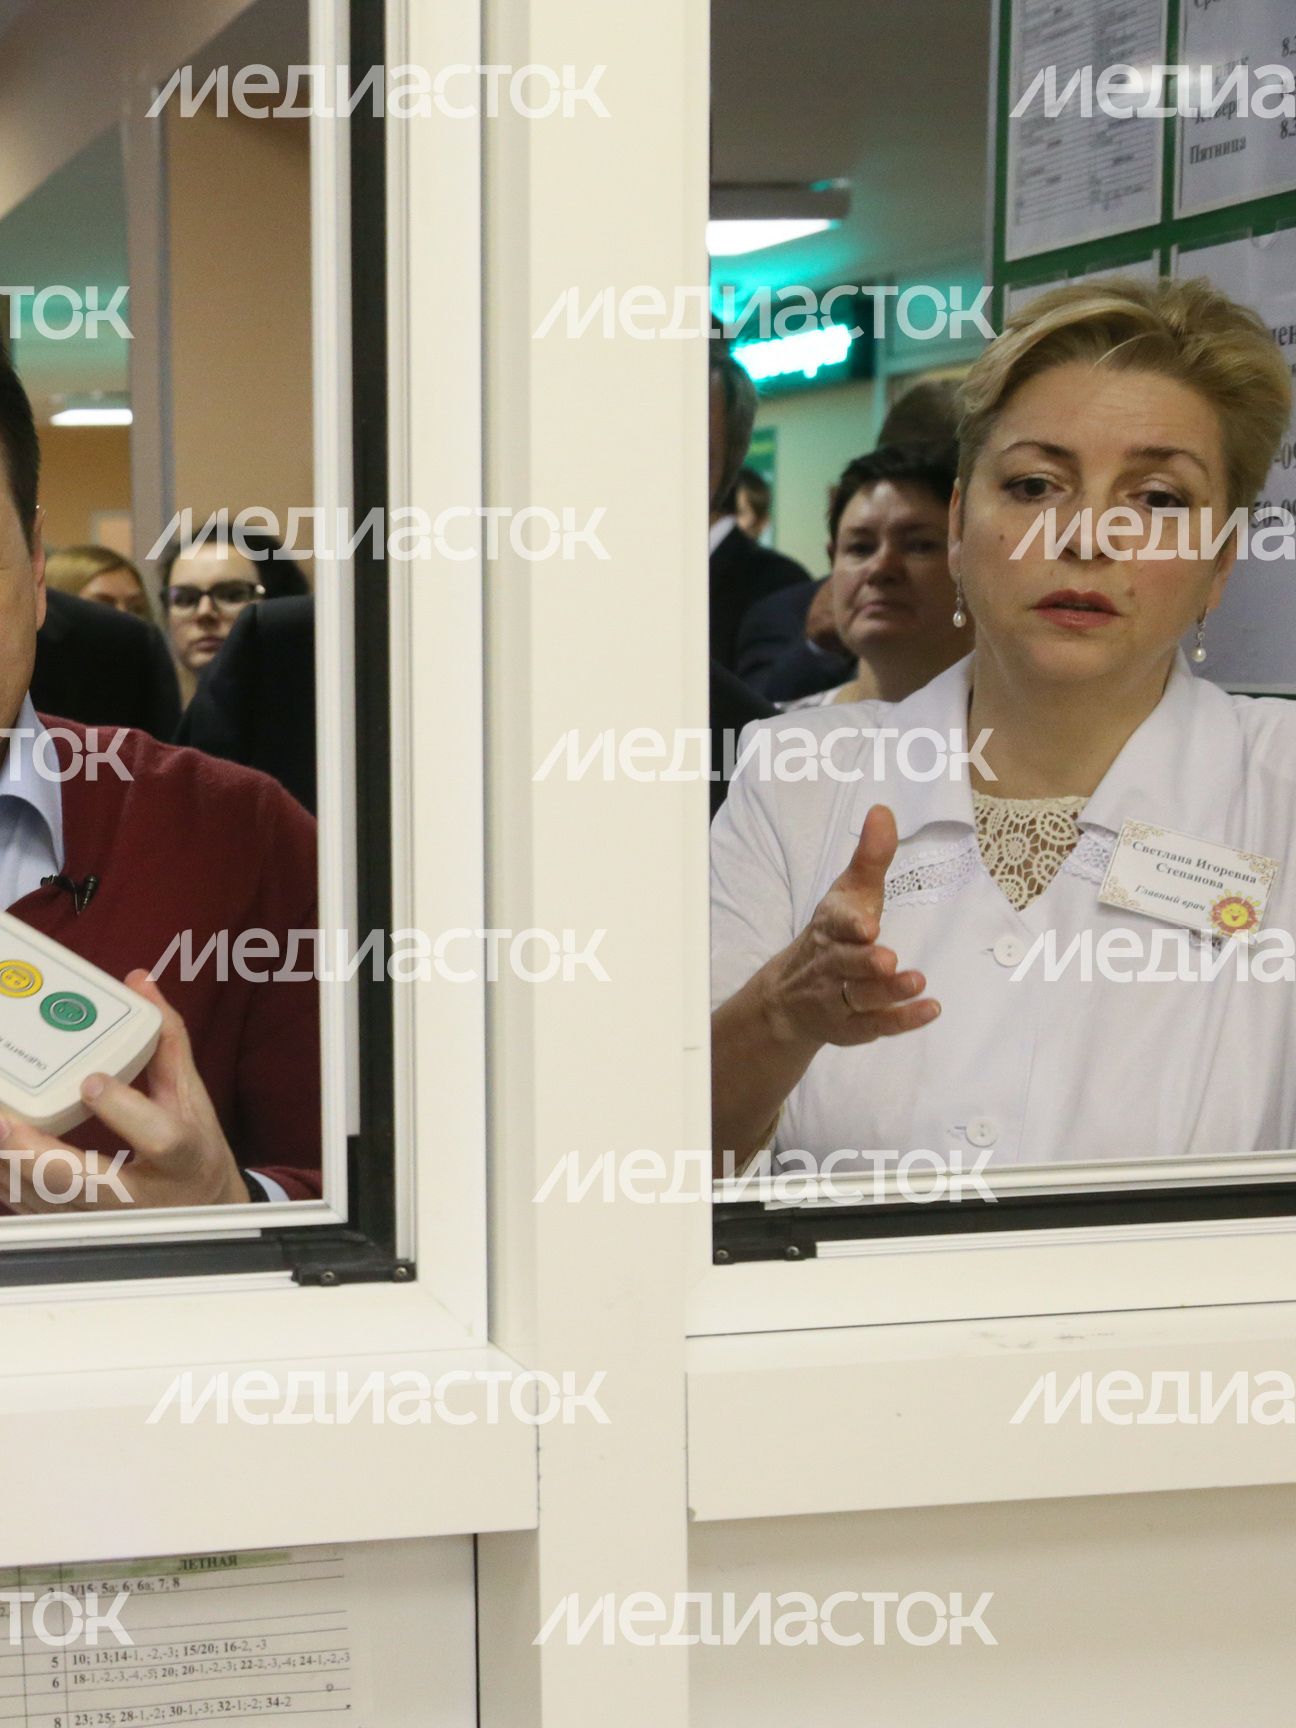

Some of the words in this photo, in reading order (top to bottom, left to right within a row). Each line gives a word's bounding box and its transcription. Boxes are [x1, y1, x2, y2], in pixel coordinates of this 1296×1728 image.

[1190, 138, 1247, 164] Пятница
[1131, 840, 1193, 866] Светлана
[1196, 858, 1257, 884] Игоревна
[1155, 862, 1224, 890] Степанова
[1134, 884, 1180, 906] Главный
[1181, 899, 1206, 913] врач
[172, 1576, 181, 1588] 8
[51, 1655, 60, 1669] 5
[73, 1653, 92, 1666] 10;
[183, 1643, 219, 1657] 15/20;
[161, 1666, 179, 1680] 20;
[52, 1677, 60, 1689] 6
[54, 1716, 62, 1728] 8
[75, 1713, 93, 1727] 23;
[97, 1711, 116, 1725] 25;
